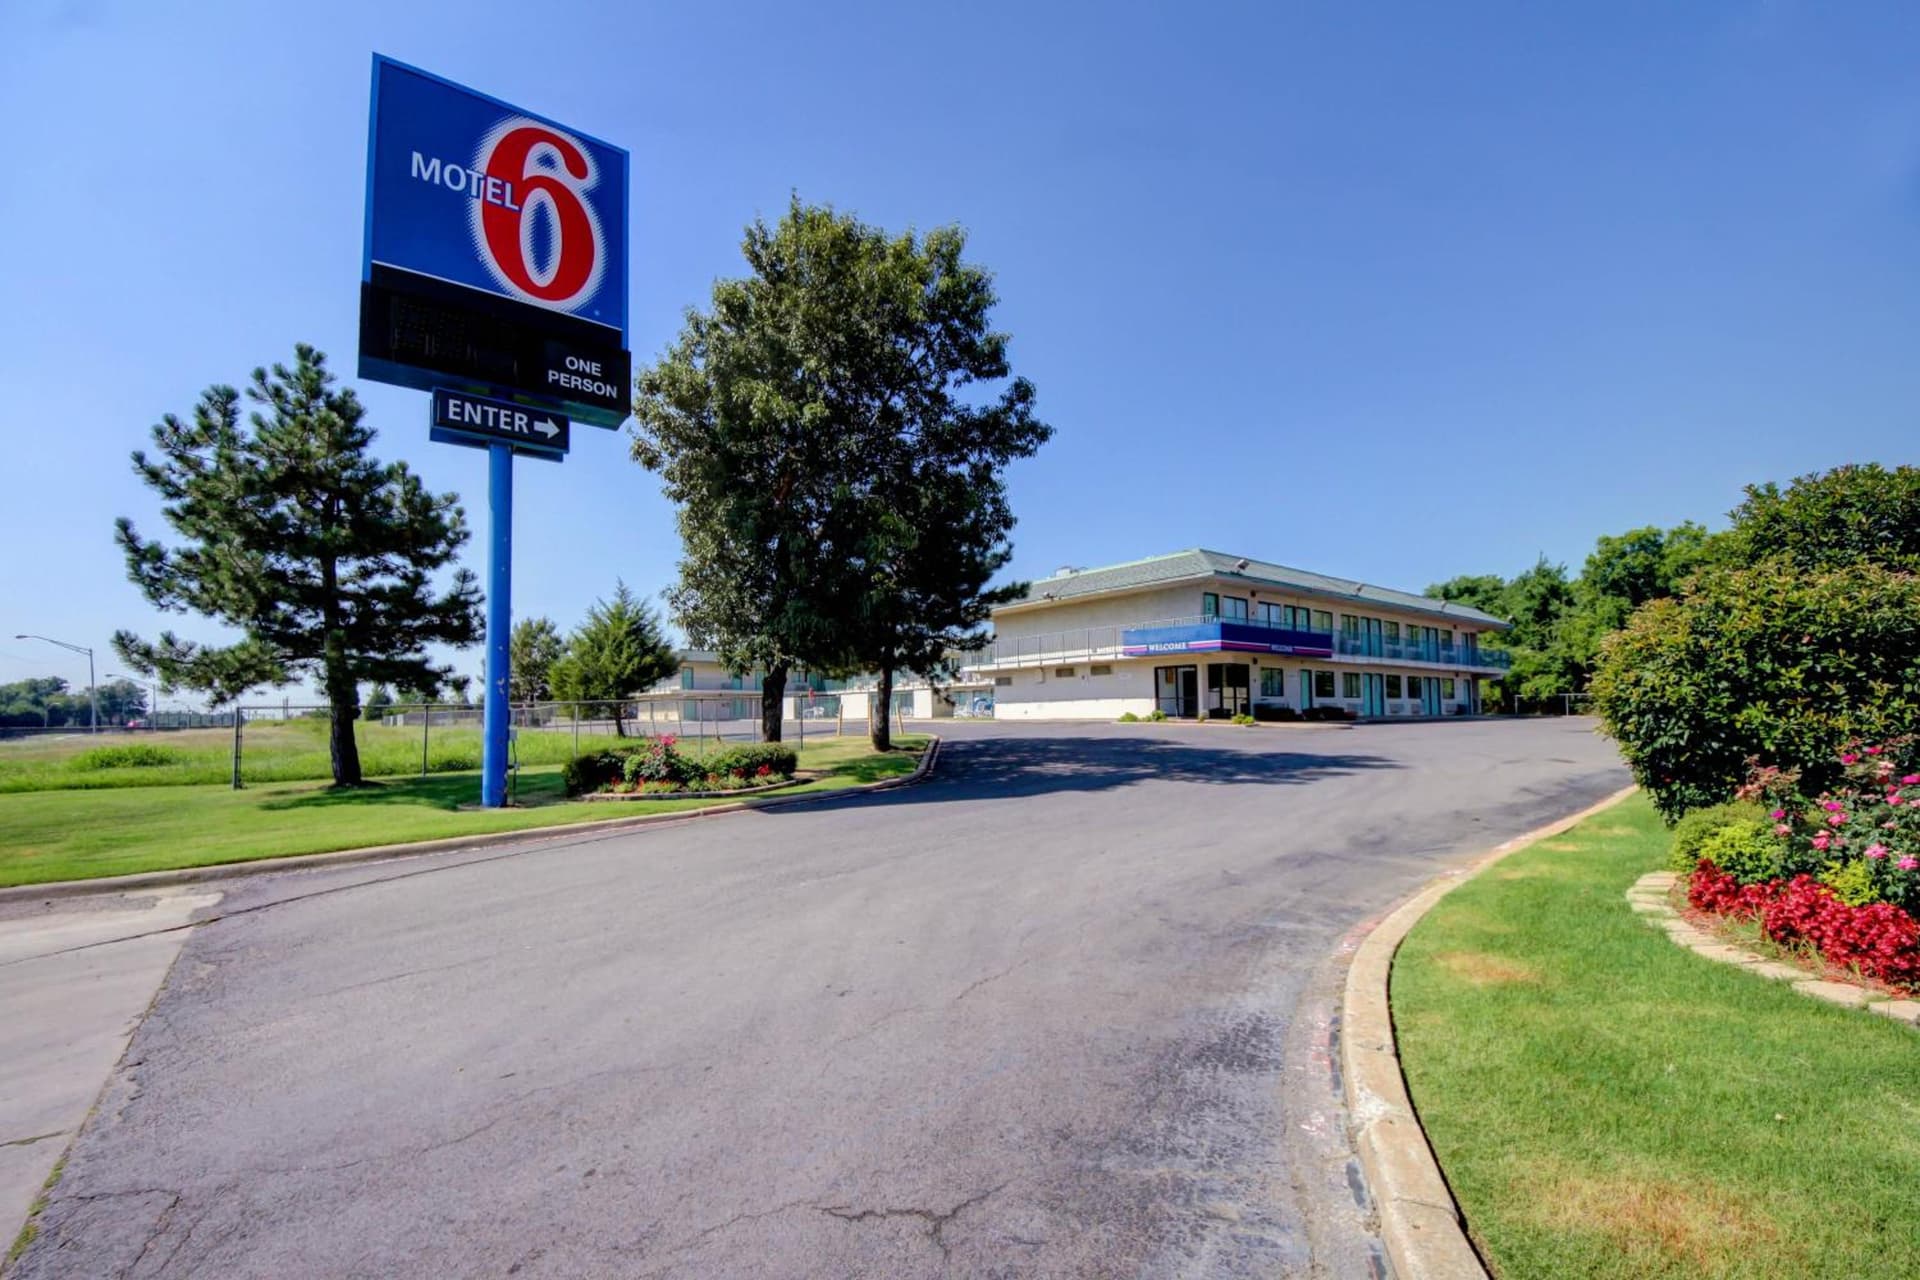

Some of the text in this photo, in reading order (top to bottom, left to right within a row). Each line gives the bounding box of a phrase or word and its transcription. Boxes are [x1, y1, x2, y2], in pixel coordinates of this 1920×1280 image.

[411, 125, 597, 303] MOTEL 6
[564, 355, 602, 377] ONE
[547, 369, 618, 399] PERSON
[447, 398, 530, 434] ENTER
[1148, 641, 1188, 652] WELCOME
